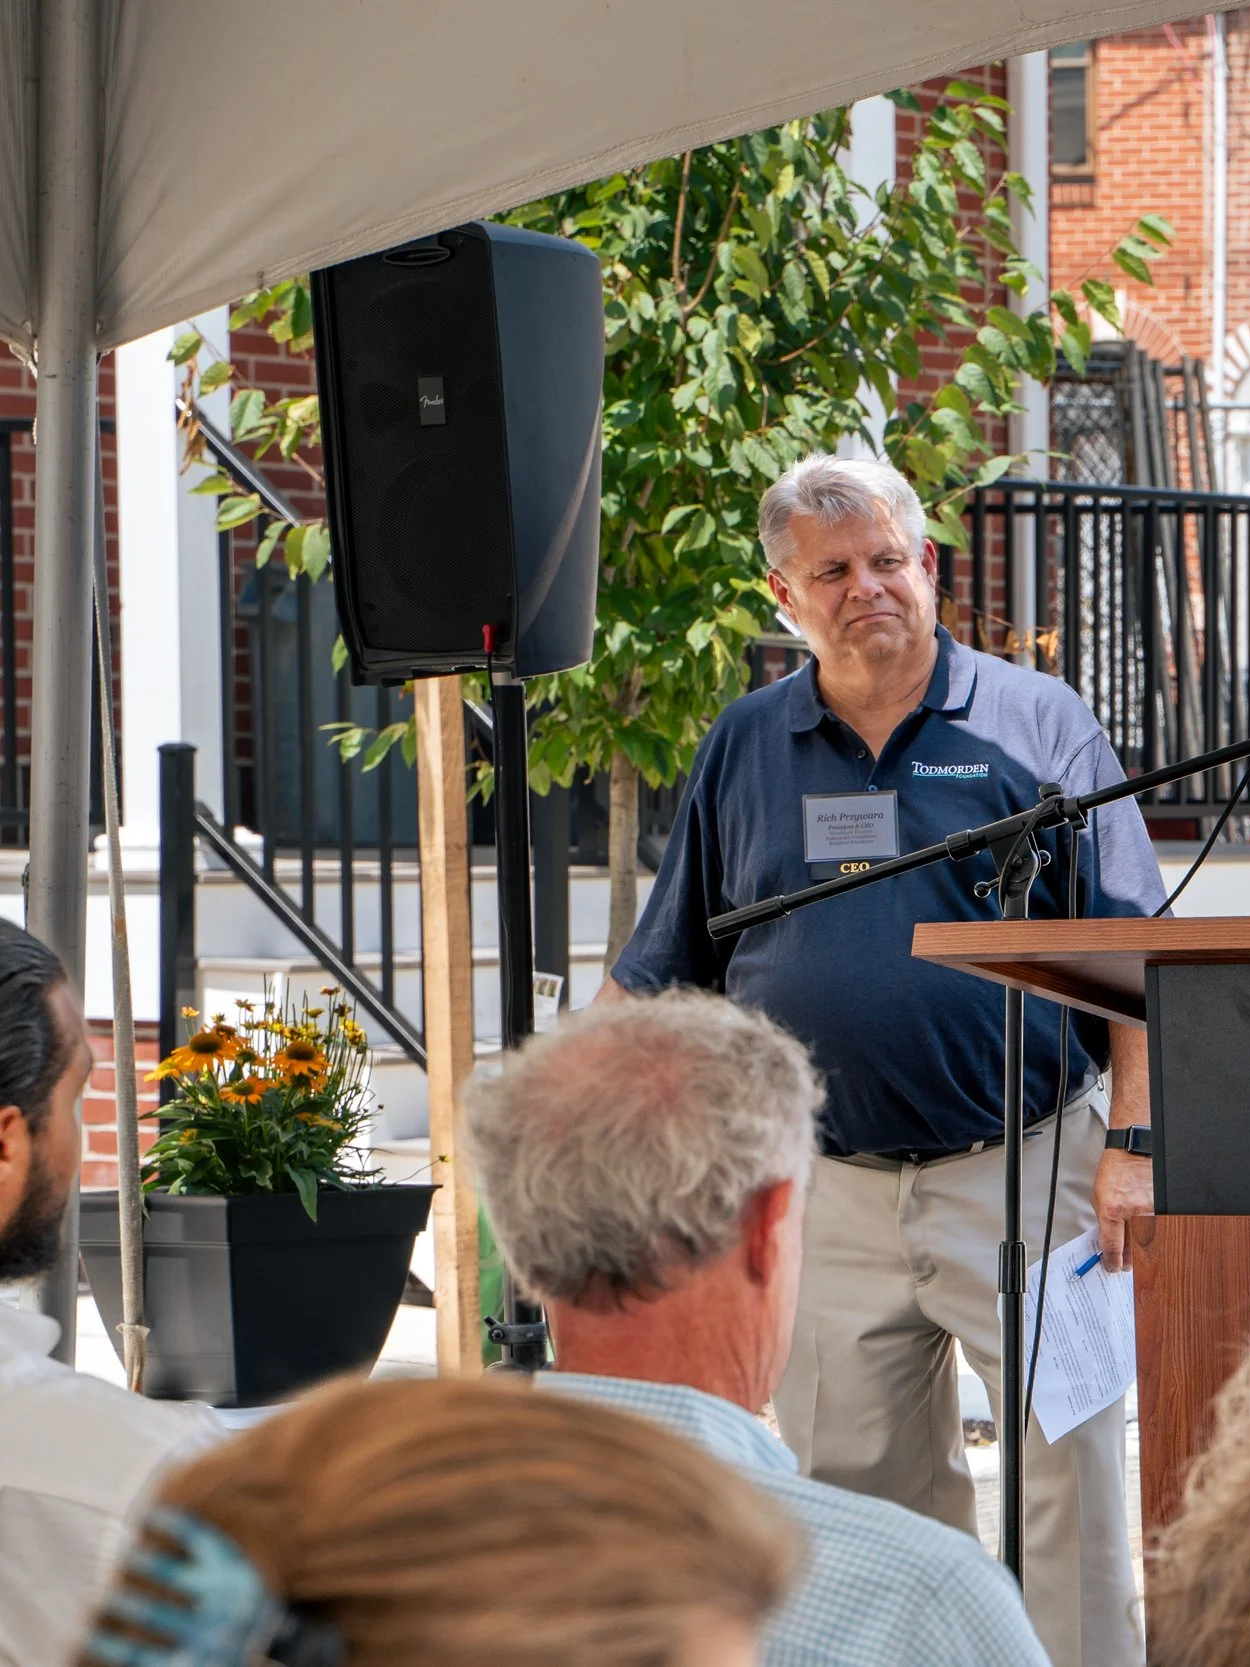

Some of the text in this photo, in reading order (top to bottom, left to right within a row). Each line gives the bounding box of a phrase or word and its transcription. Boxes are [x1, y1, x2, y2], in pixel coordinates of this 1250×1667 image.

[816, 812, 884, 823] Rich Przywara
[840, 862, 870, 874] CEO
